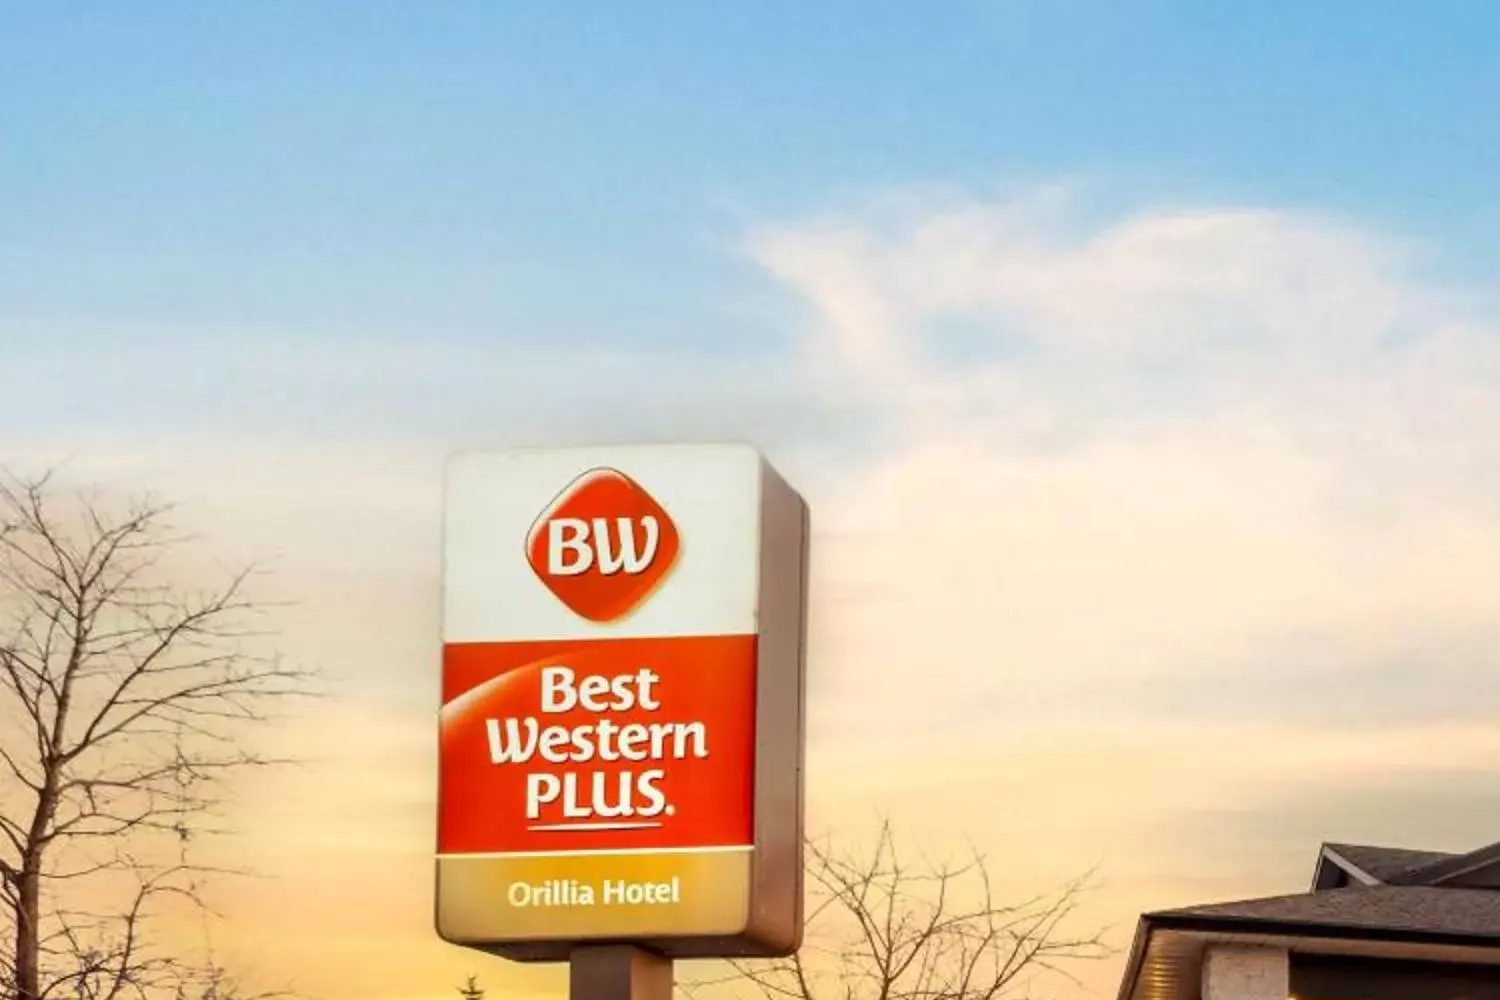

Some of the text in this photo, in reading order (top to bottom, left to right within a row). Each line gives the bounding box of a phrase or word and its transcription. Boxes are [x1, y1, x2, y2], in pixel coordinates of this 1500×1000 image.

[548, 516, 659, 575] BW
[541, 666, 660, 713] Best
[485, 717, 708, 764] Western
[508, 877, 680, 907] Orillia Hotel
